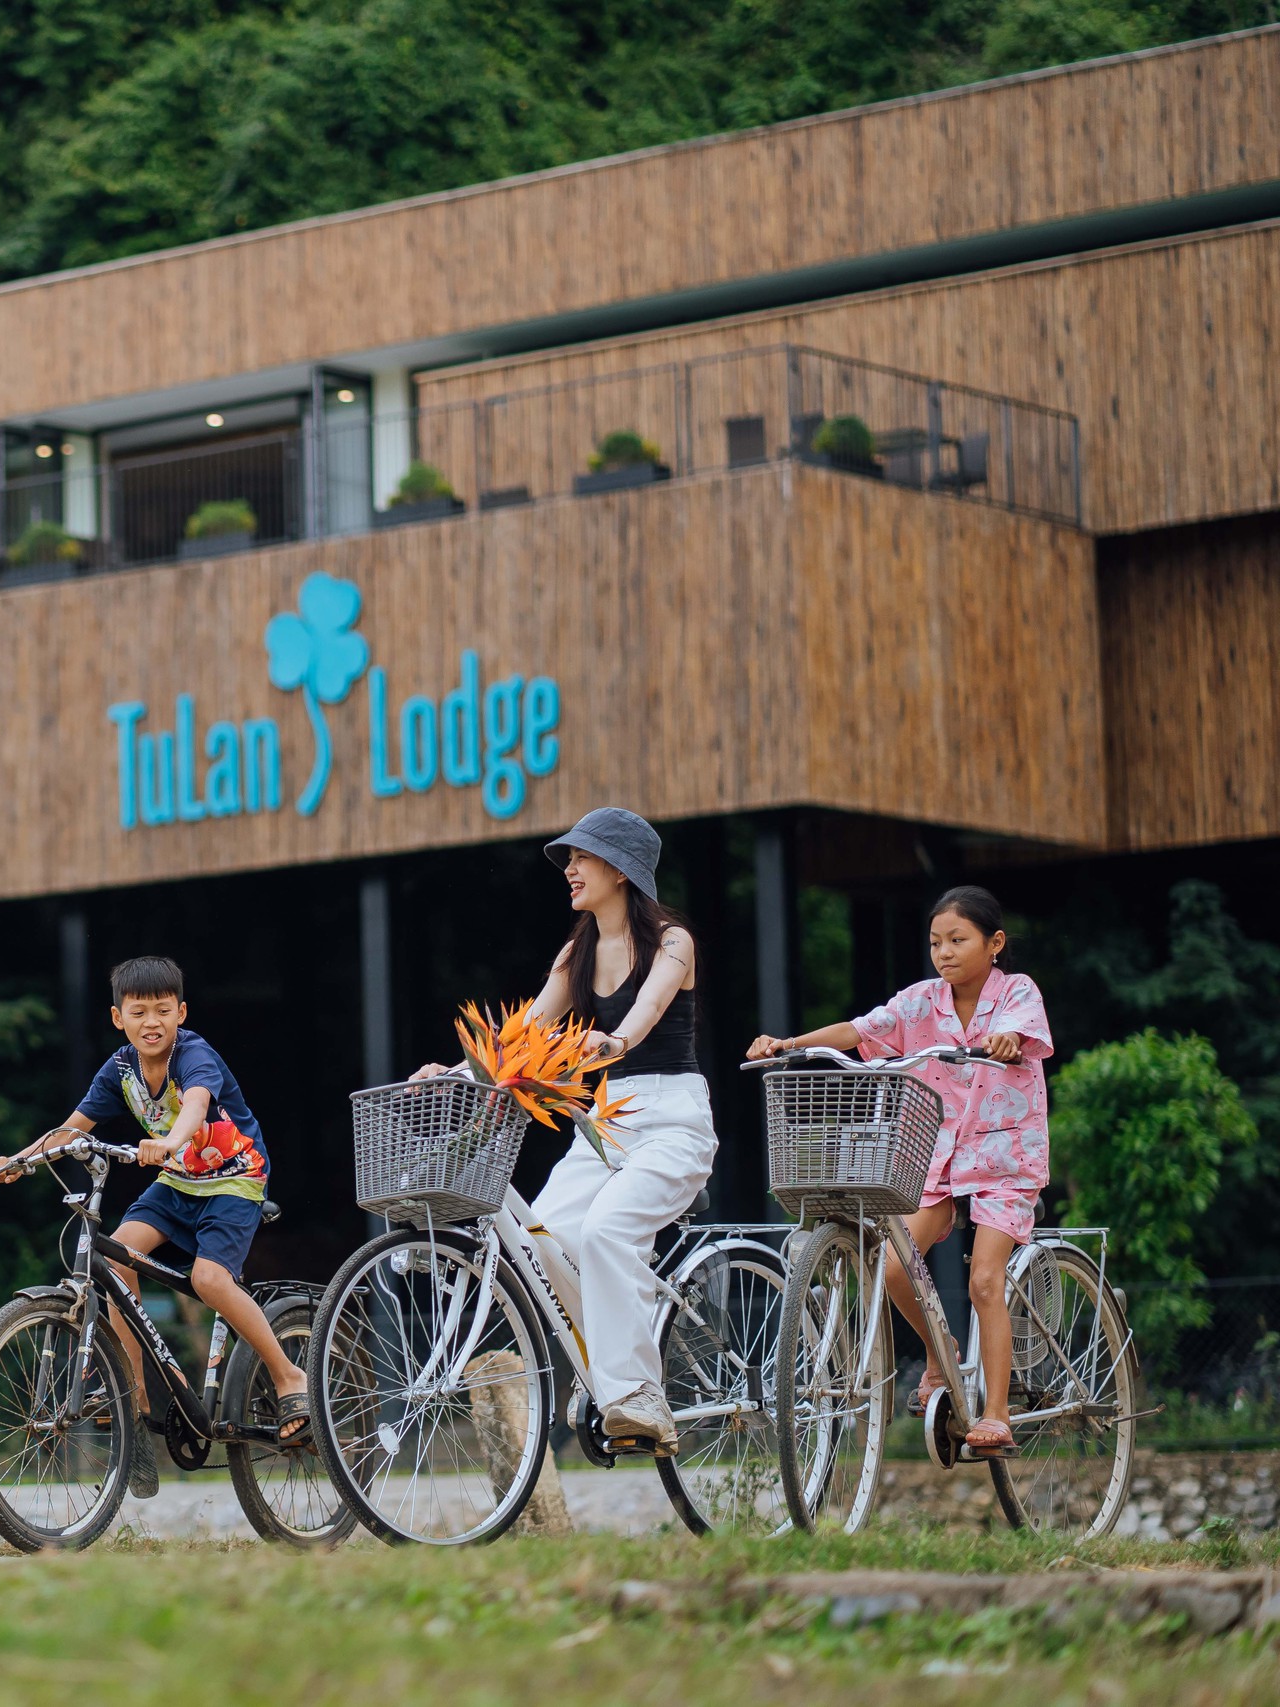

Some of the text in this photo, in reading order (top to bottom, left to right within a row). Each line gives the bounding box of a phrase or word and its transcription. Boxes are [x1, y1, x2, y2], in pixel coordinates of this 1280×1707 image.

[107, 648, 561, 830] TuLan Lodge
[127, 1294, 174, 1359] LUCKY
[520, 1245, 573, 1332] ASAMA
[154, 1347, 167, 1362] BIKE
